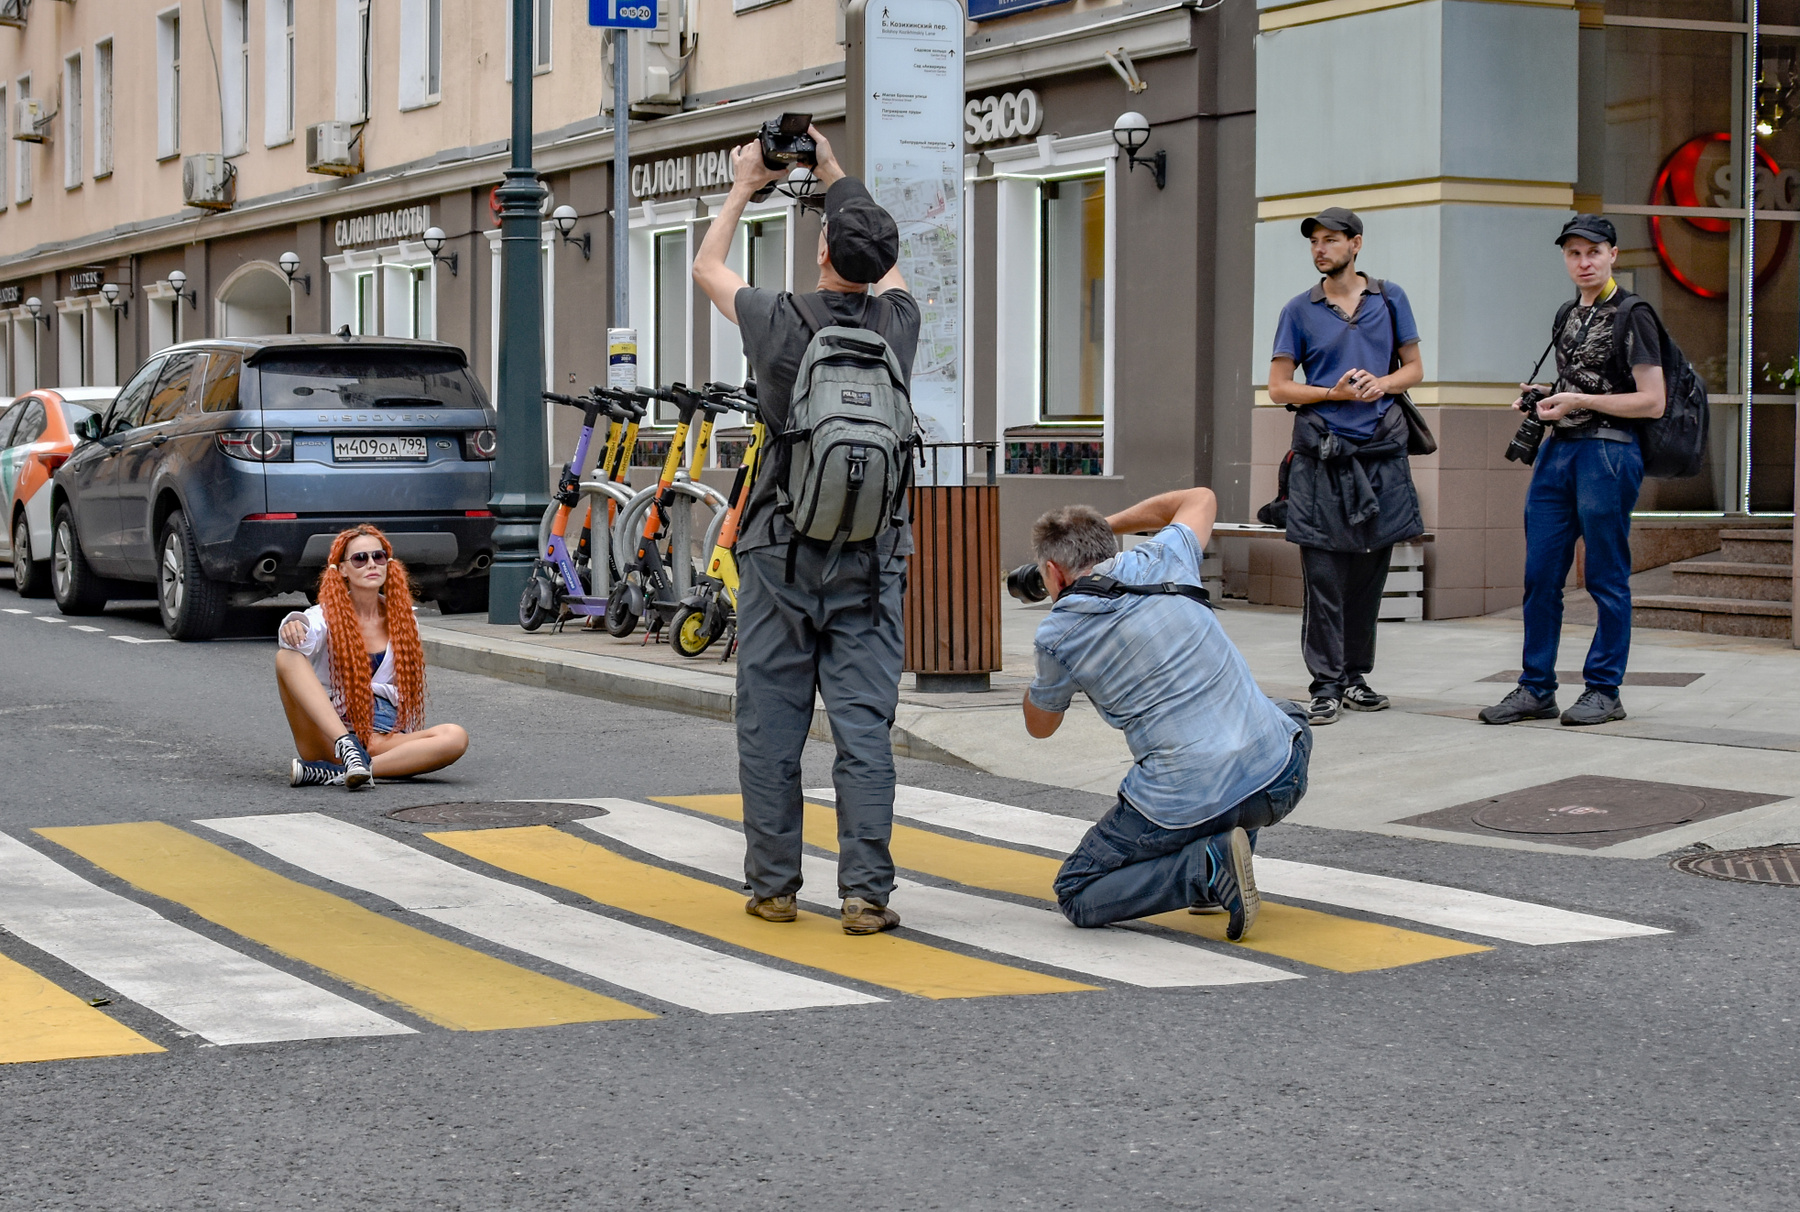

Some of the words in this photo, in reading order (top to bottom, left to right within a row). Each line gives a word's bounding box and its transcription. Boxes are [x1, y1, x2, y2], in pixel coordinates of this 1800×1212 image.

[638, 9, 650, 17] 20
[890, 21, 932, 29] Козихинский
[964, 88, 1043, 145] saco
[631, 156, 691, 198] САЛОН
[335, 214, 374, 246] САЛОН
[375, 204, 431, 240] КРАСОТЫ
[317, 413, 441, 423] DISCOVERY
[400, 438, 423, 450] 799
